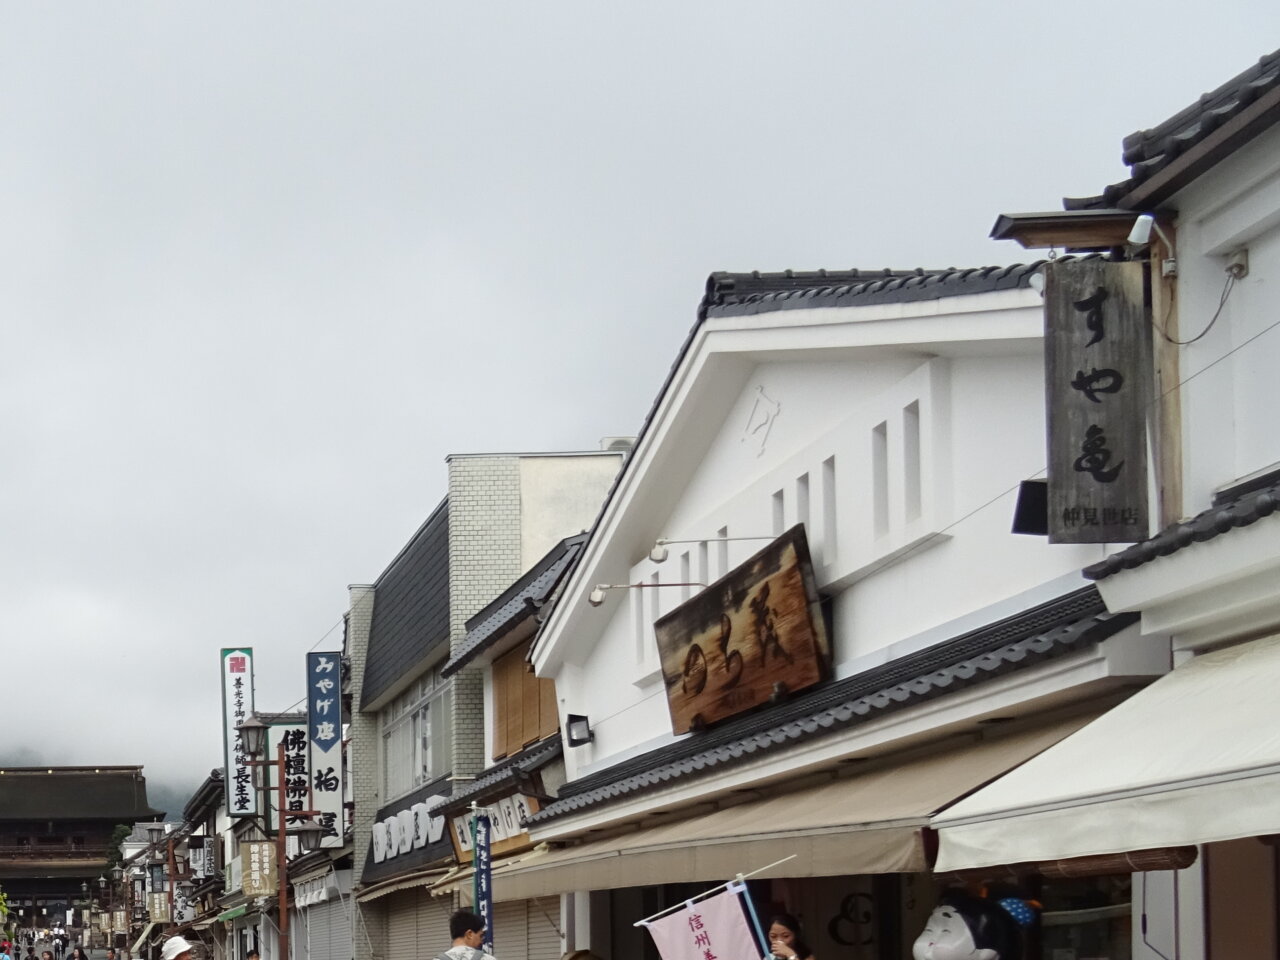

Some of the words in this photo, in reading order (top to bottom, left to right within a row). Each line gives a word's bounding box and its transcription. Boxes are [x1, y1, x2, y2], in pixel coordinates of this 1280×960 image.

[1071, 286, 1124, 484] すや亀
[316, 657, 335, 741] みやげ店
[233, 766, 251, 812] 長生堂
